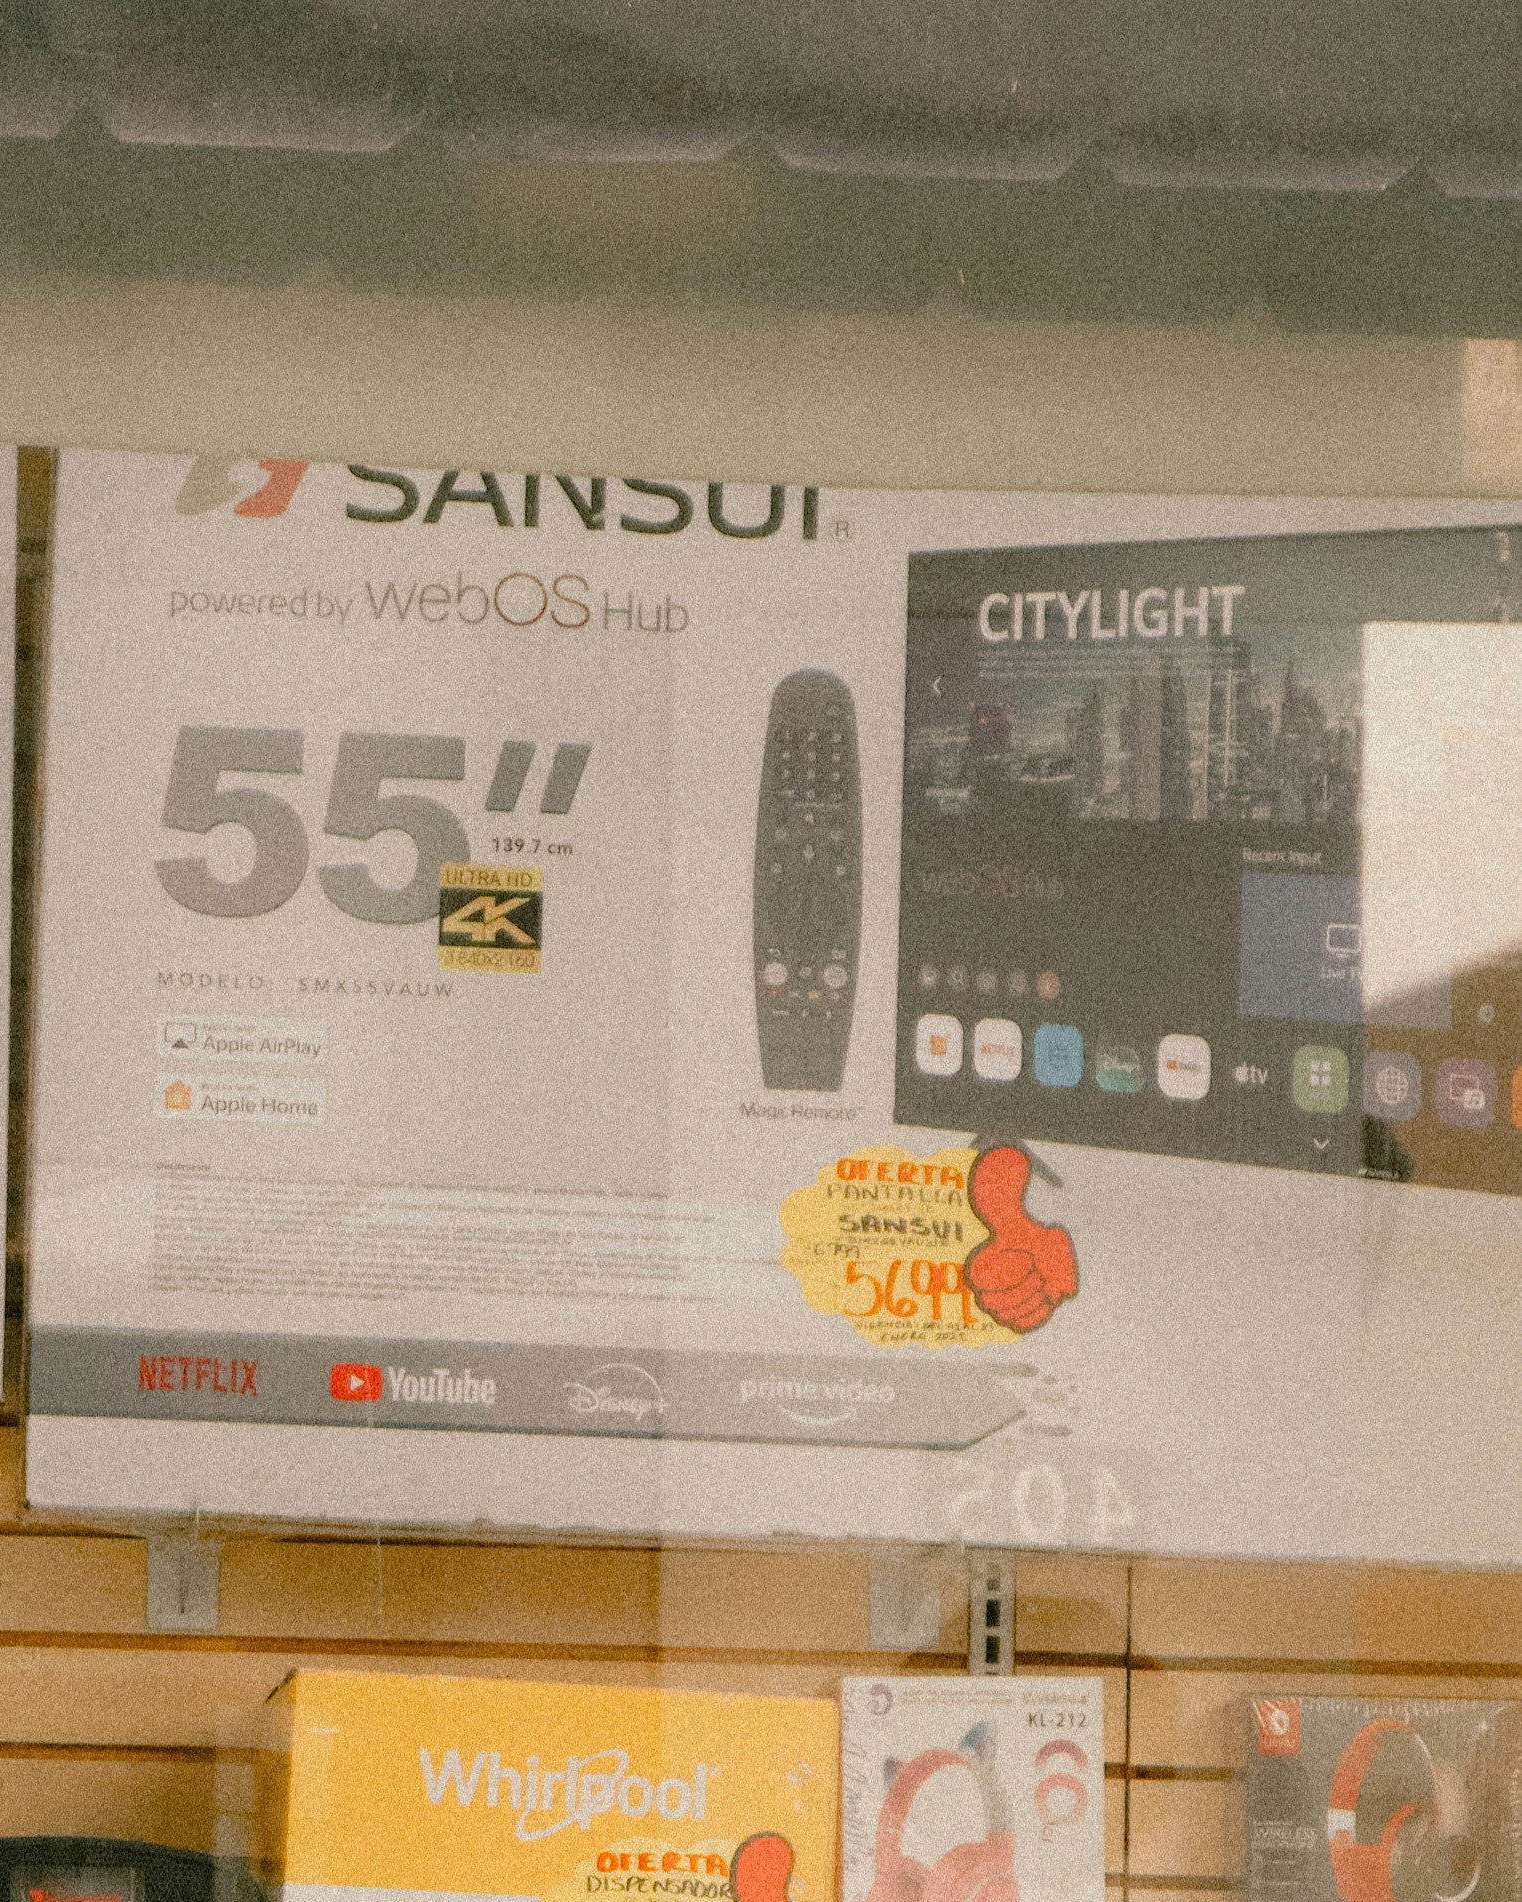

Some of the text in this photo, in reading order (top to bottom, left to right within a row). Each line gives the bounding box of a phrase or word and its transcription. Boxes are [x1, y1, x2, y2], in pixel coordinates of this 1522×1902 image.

[169, 586, 309, 622] powered
[316, 589, 354, 626] by
[601, 592, 691, 634] Hub
[979, 586, 1245, 642] CITYLIGHT
[546, 842, 574, 856] cm
[445, 870, 533, 888] ULTRA HD
[442, 896, 537, 946] 4K
[202, 1034, 323, 1058] Apple AirPlay
[200, 1094, 319, 1117] Apple Home
[836, 1158, 965, 1190] OFERTA
[828, 1183, 964, 1207] PANTALLA
[838, 1214, 964, 1242] SANSUI
[843, 1259, 979, 1325] 5699
[137, 1354, 260, 1397] NETFLIX
[388, 1366, 497, 1406] YouTube
[1027, 1712, 1088, 1729] KL-212
[419, 1747, 709, 1840] Whirlpool
[596, 1851, 729, 1878] OFERTA
[585, 1875, 733, 1900] DISPENSADOR
